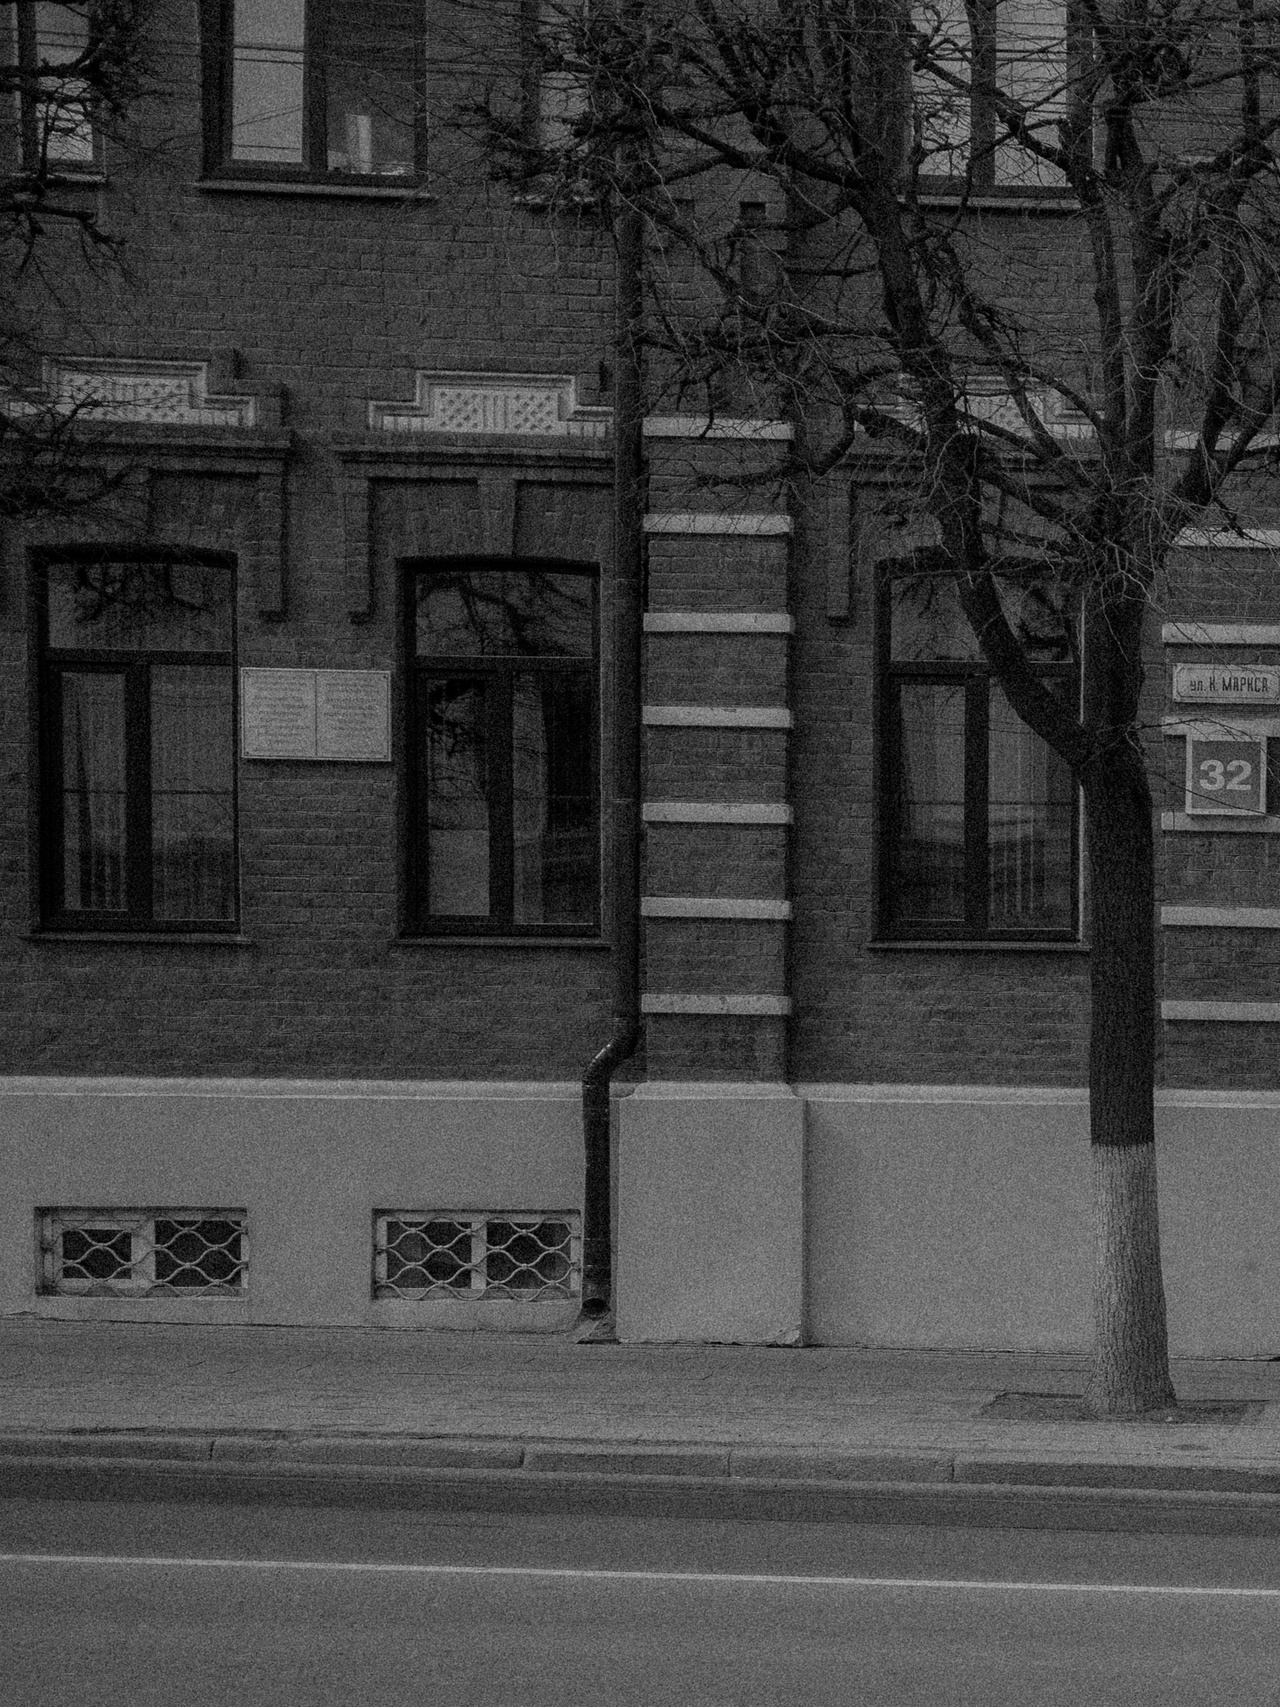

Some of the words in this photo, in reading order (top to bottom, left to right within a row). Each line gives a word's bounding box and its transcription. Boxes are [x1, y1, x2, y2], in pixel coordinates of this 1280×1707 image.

[1190, 680, 1207, 692] ул.
[1222, 676, 1268, 692] МАРКСА
[1199, 759, 1252, 791] 32
